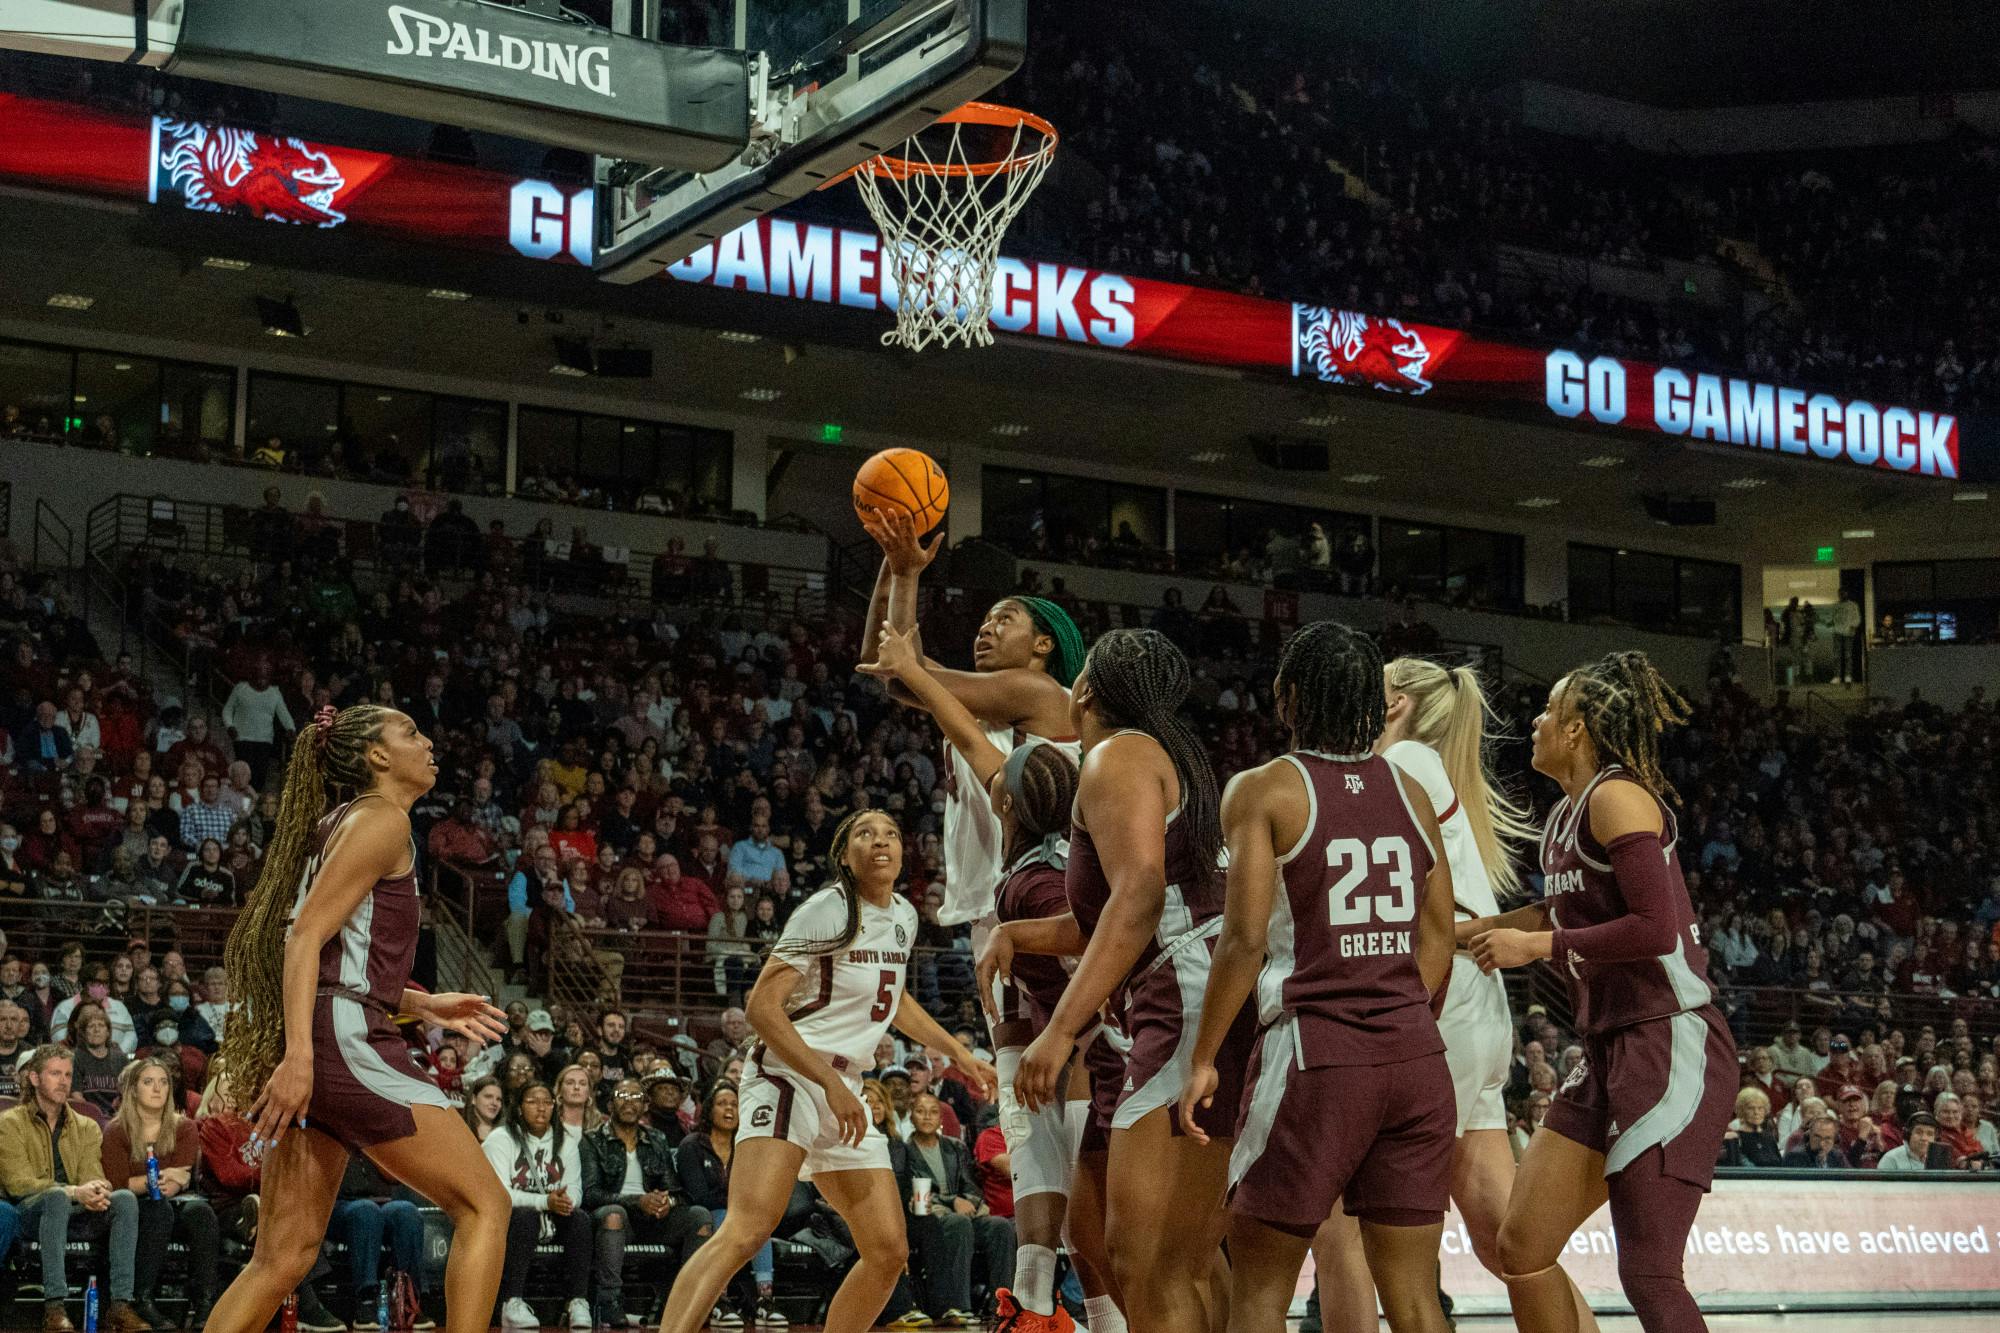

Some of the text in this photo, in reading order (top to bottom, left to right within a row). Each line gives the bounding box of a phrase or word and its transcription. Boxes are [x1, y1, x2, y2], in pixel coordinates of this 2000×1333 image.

[387, 5, 612, 97] SPALDING
[1546, 348, 1959, 480] GO GAMECOCK
[1326, 836, 1416, 925] 23
[848, 950, 880, 964] SOUTH
[1340, 931, 1411, 958] GREEN
[870, 969, 897, 1022] 5
[433, 1239, 448, 1258] 10
[1776, 1224, 1850, 1254] have
[1858, 1224, 1990, 1254] achieved
